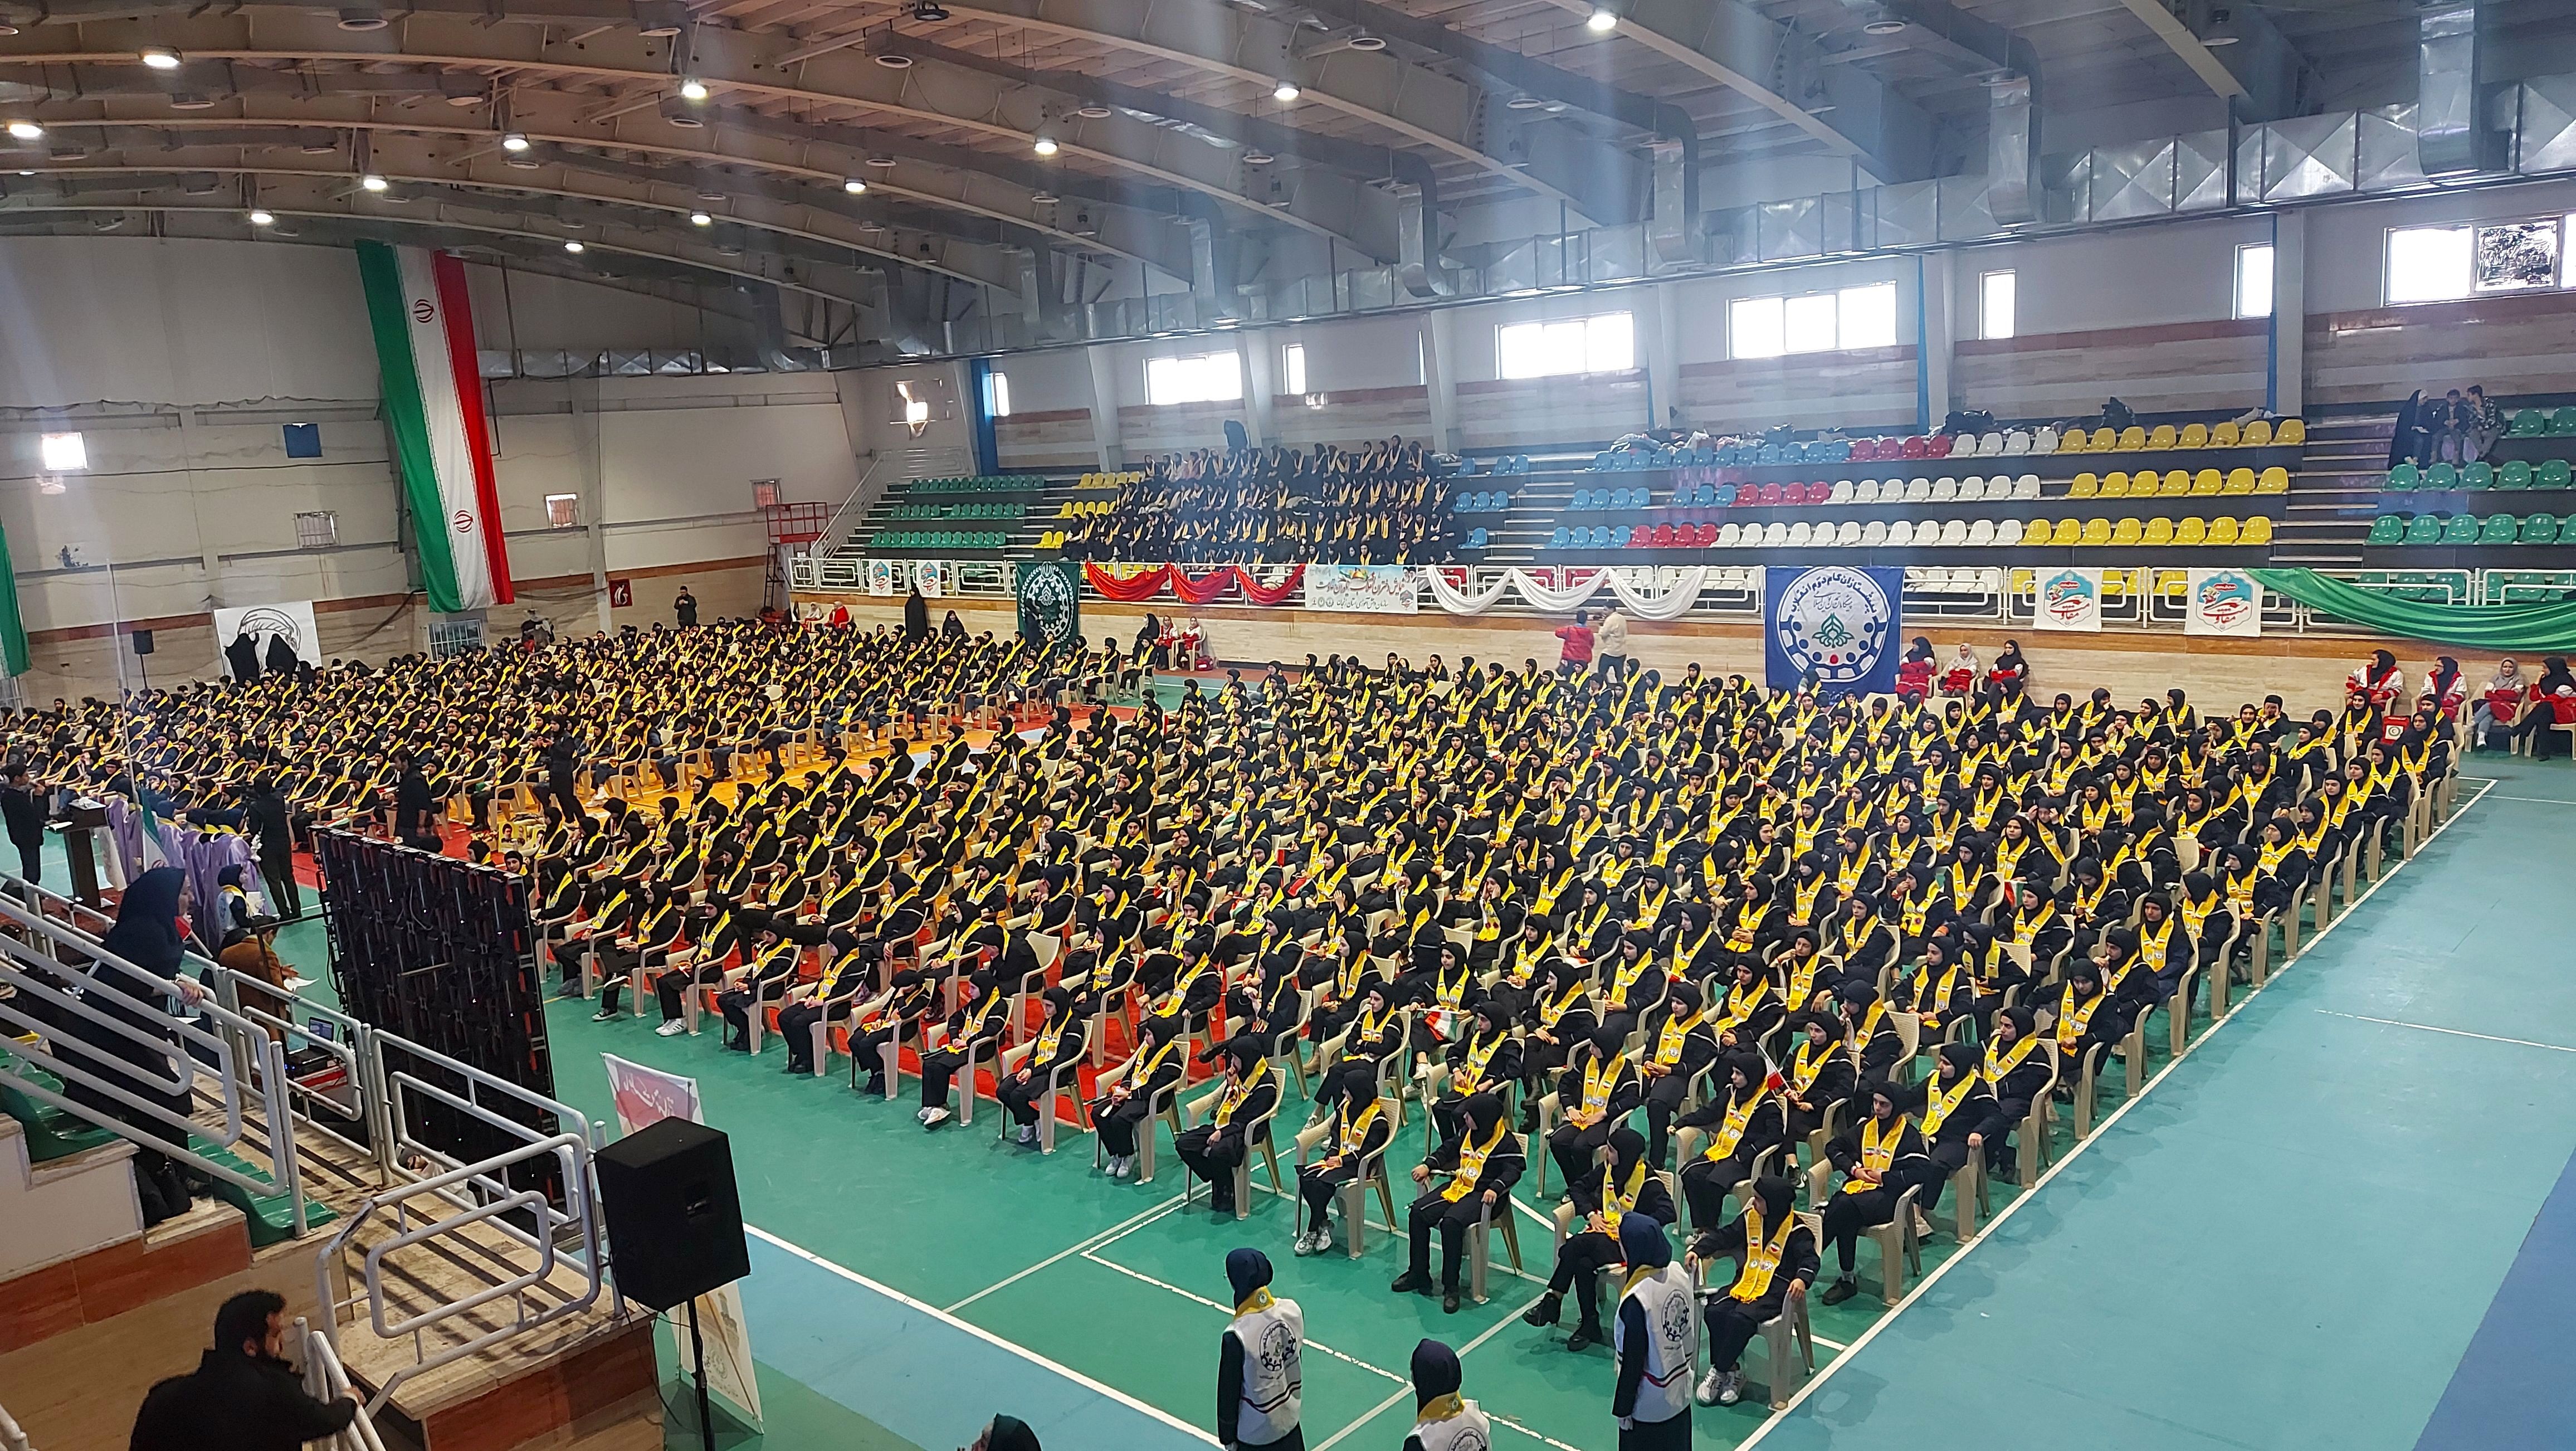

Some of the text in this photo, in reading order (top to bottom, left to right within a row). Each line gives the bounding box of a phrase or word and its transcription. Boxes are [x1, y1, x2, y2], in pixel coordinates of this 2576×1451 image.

[1791, 583, 1812, 612] انقلاب
[1840, 575, 1877, 614] پیشتازان
[2050, 602, 2090, 620] مقاومت
[2203, 605, 2248, 624] مقاومت
